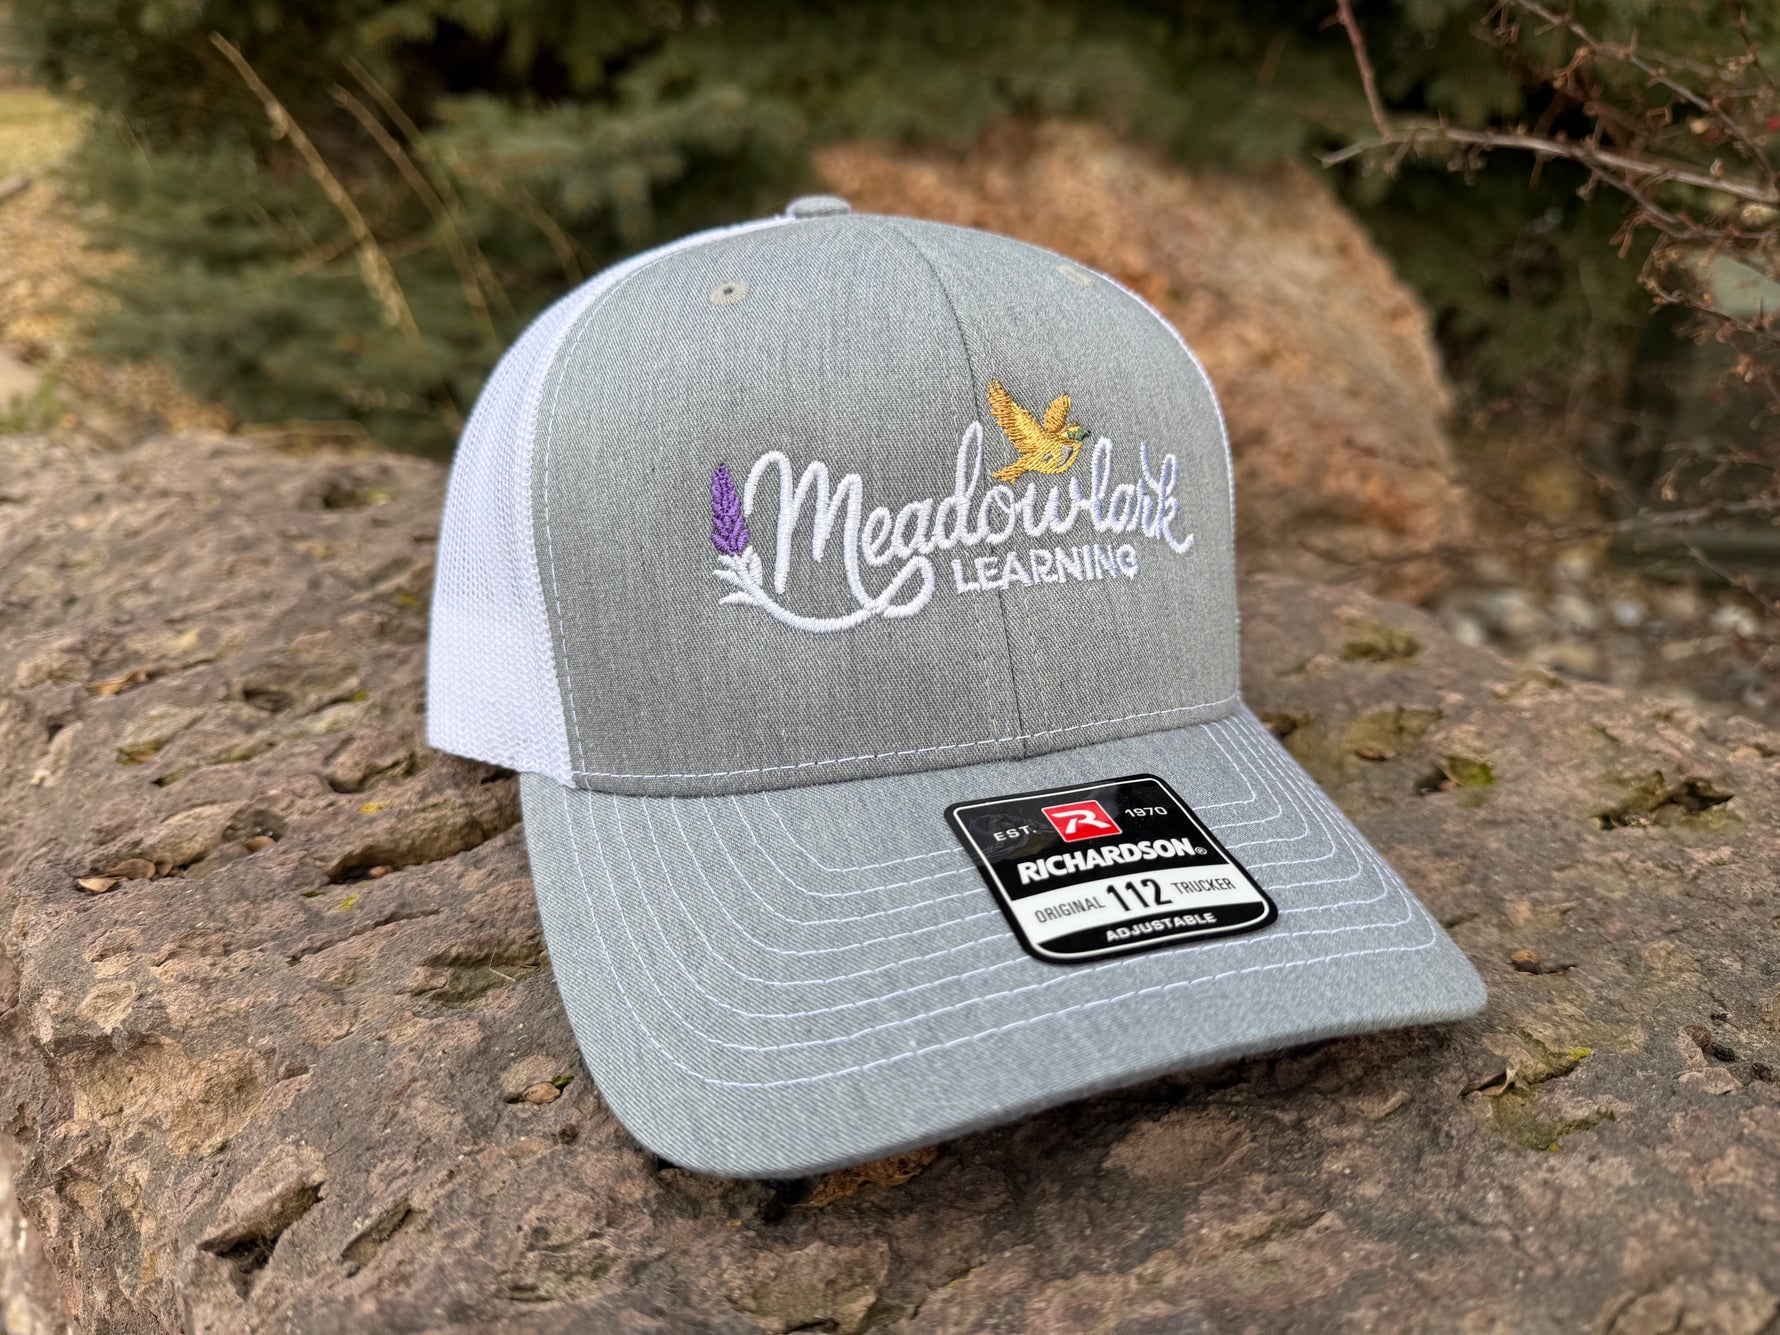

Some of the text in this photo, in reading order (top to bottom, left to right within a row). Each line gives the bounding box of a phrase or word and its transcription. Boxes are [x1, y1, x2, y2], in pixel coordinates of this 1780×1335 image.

[743, 421, 1195, 618] Meadowlark
[952, 544, 1140, 595] LEARNING
[993, 826, 1038, 842] EST.
[1124, 806, 1168, 818] 1970
[1034, 877, 1237, 924] ORIGINAL 112 TRUCKER
[1106, 912, 1218, 943] ADJUSTABLE
